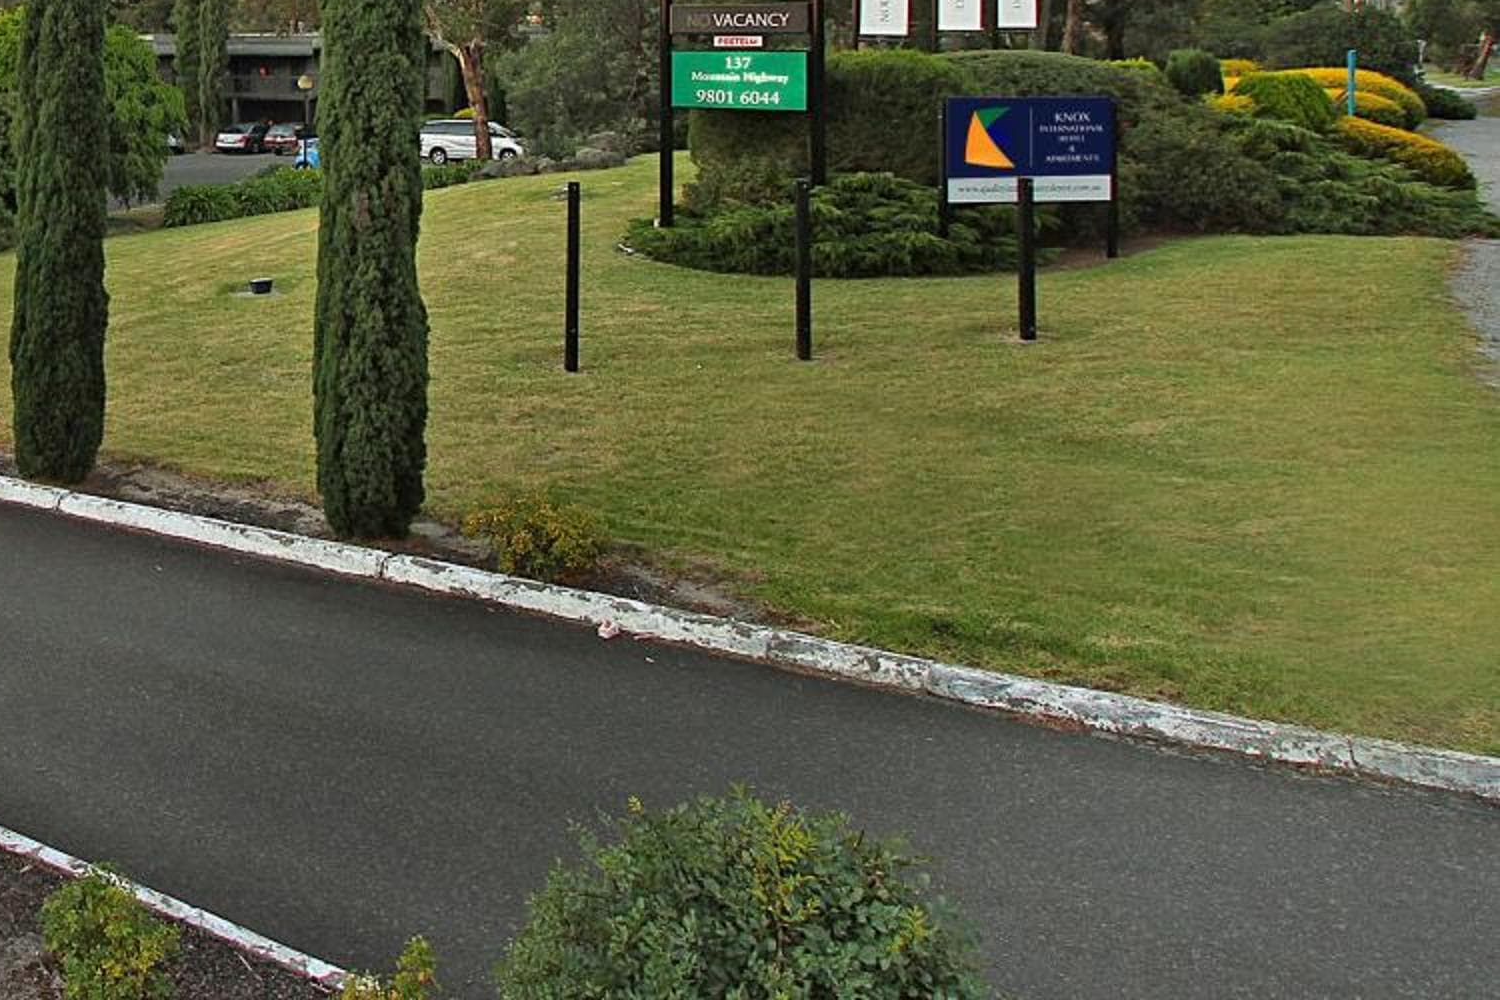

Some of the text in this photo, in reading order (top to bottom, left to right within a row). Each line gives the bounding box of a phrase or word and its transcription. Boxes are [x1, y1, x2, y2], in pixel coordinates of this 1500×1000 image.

[713, 13, 789, 27] VACANCY
[725, 55, 752, 69] 137
[691, 71, 789, 85] Mountain Highway
[696, 90, 780, 105] 9801 6044
[1055, 111, 1091, 123] KNOX
